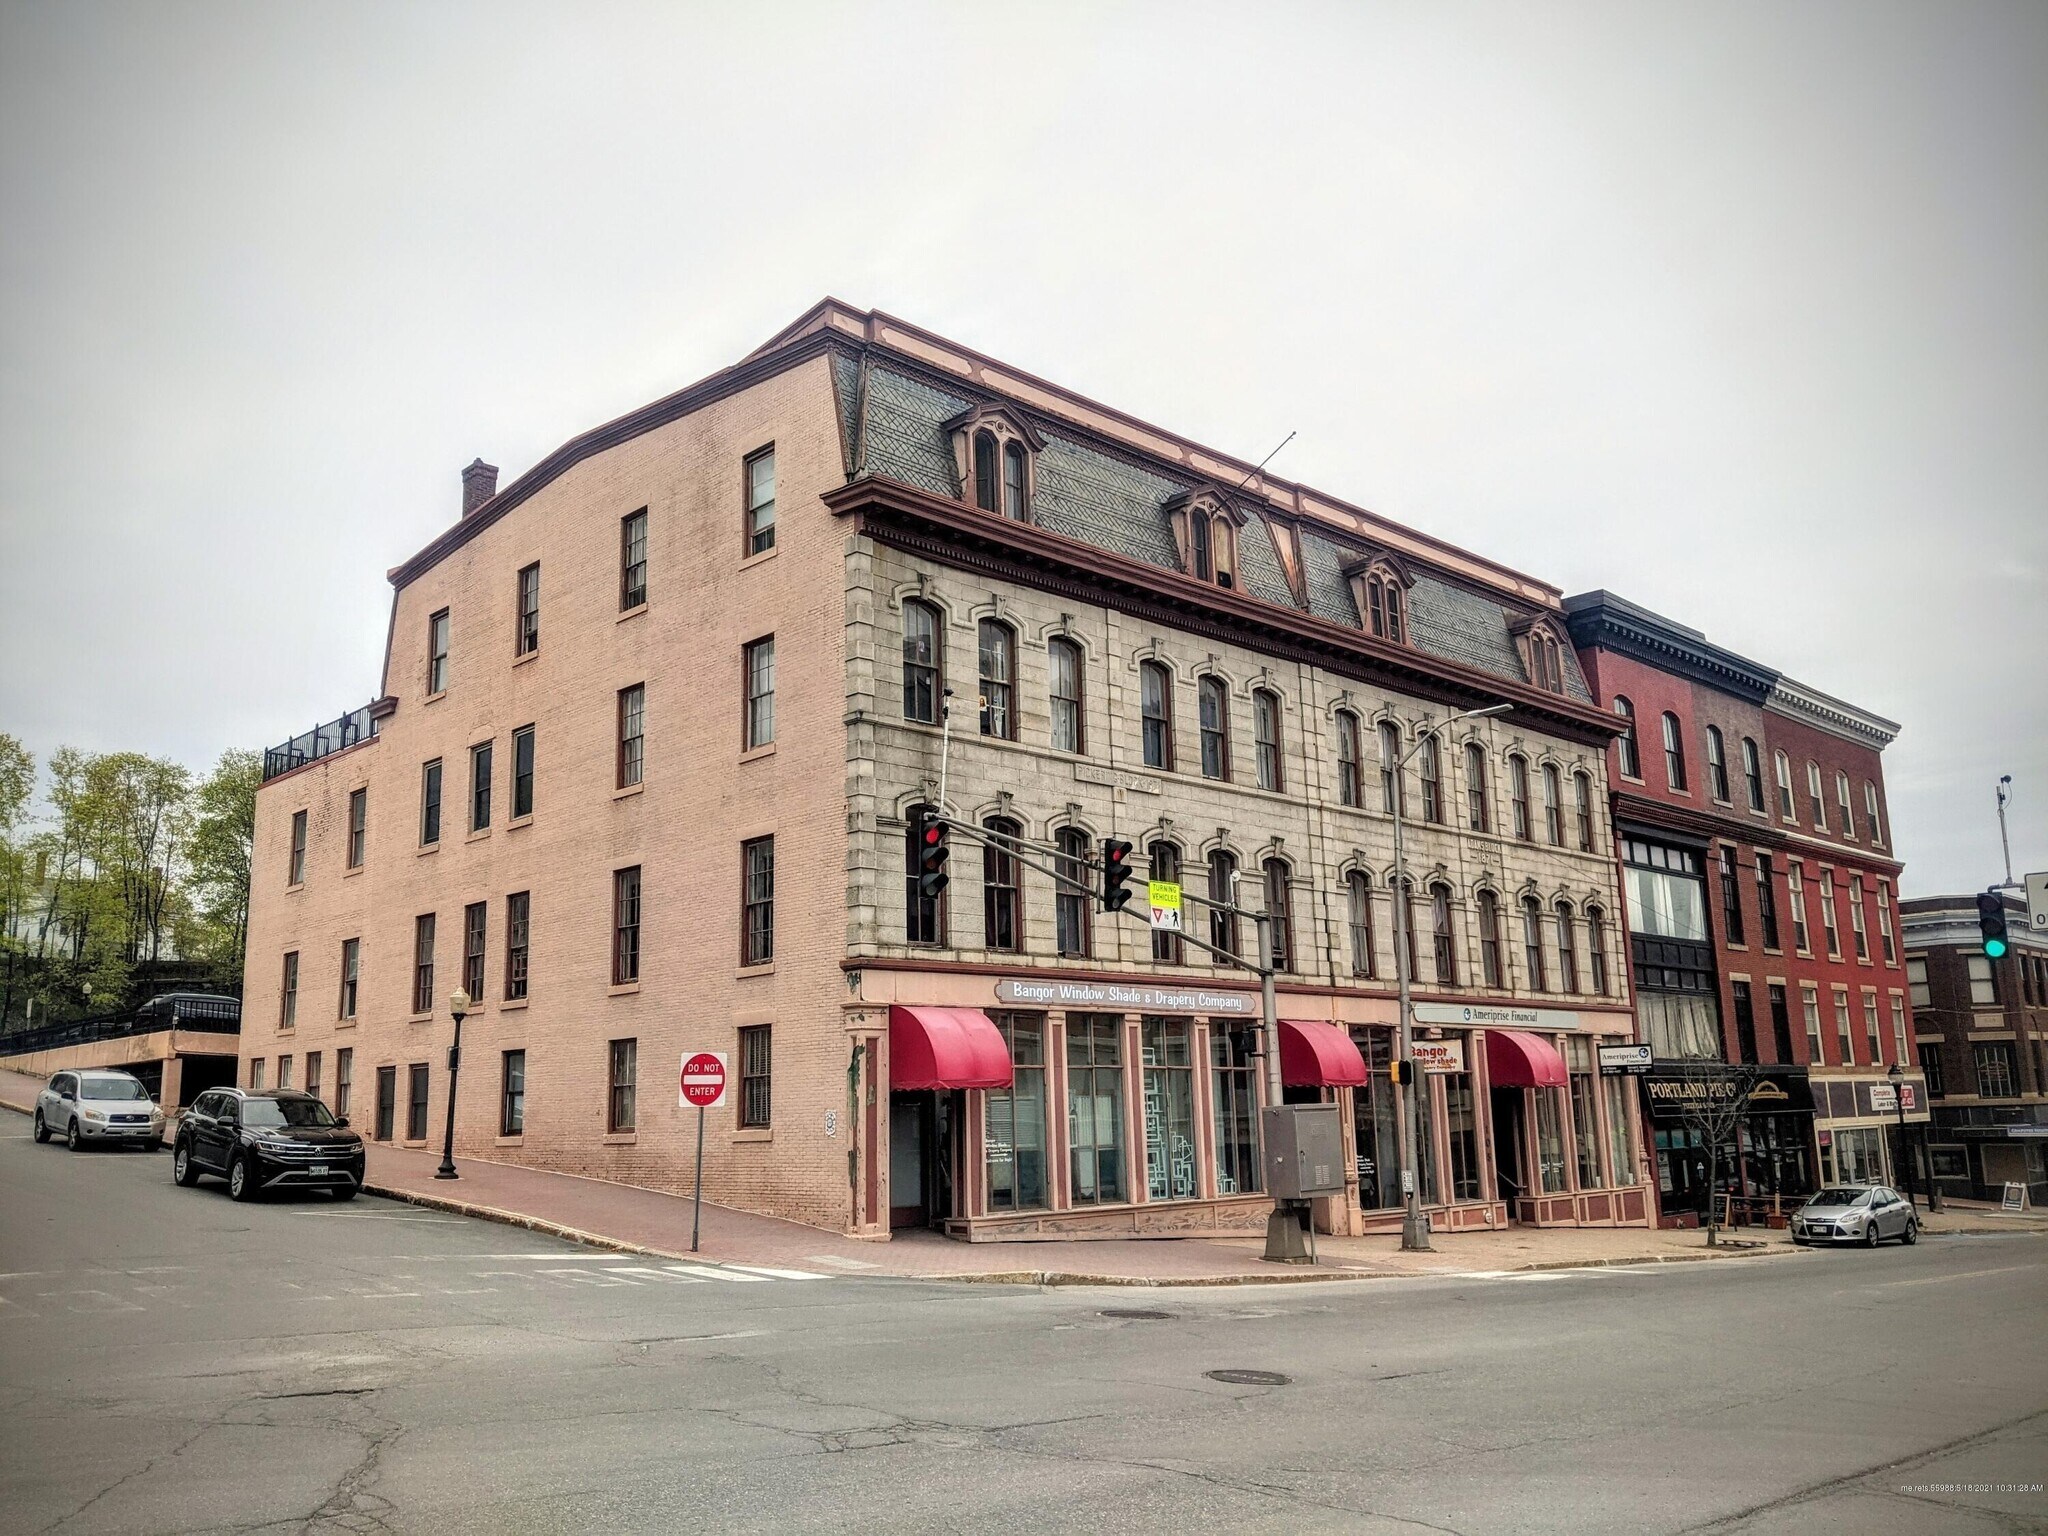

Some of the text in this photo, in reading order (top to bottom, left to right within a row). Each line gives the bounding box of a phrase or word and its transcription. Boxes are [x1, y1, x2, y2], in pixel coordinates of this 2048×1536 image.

[1153, 883, 1177, 893] TURNING
[1152, 892, 1178, 903] VEHICLES
[1013, 982, 1055, 1001] Bangor
[1059, 985, 1104, 1000] Window
[1109, 986, 1141, 1003] Shade
[1155, 991, 1196, 1008] Drapery
[1199, 993, 1242, 1011] Company
[1473, 1008, 1538, 1023] Ameriprise Financial
[1411, 1046, 1447, 1059] Bangor
[688, 1064, 719, 1072] DO NOT
[690, 1087, 715, 1095] ENTER
[1648, 1083, 1706, 1098] PORTLAND
